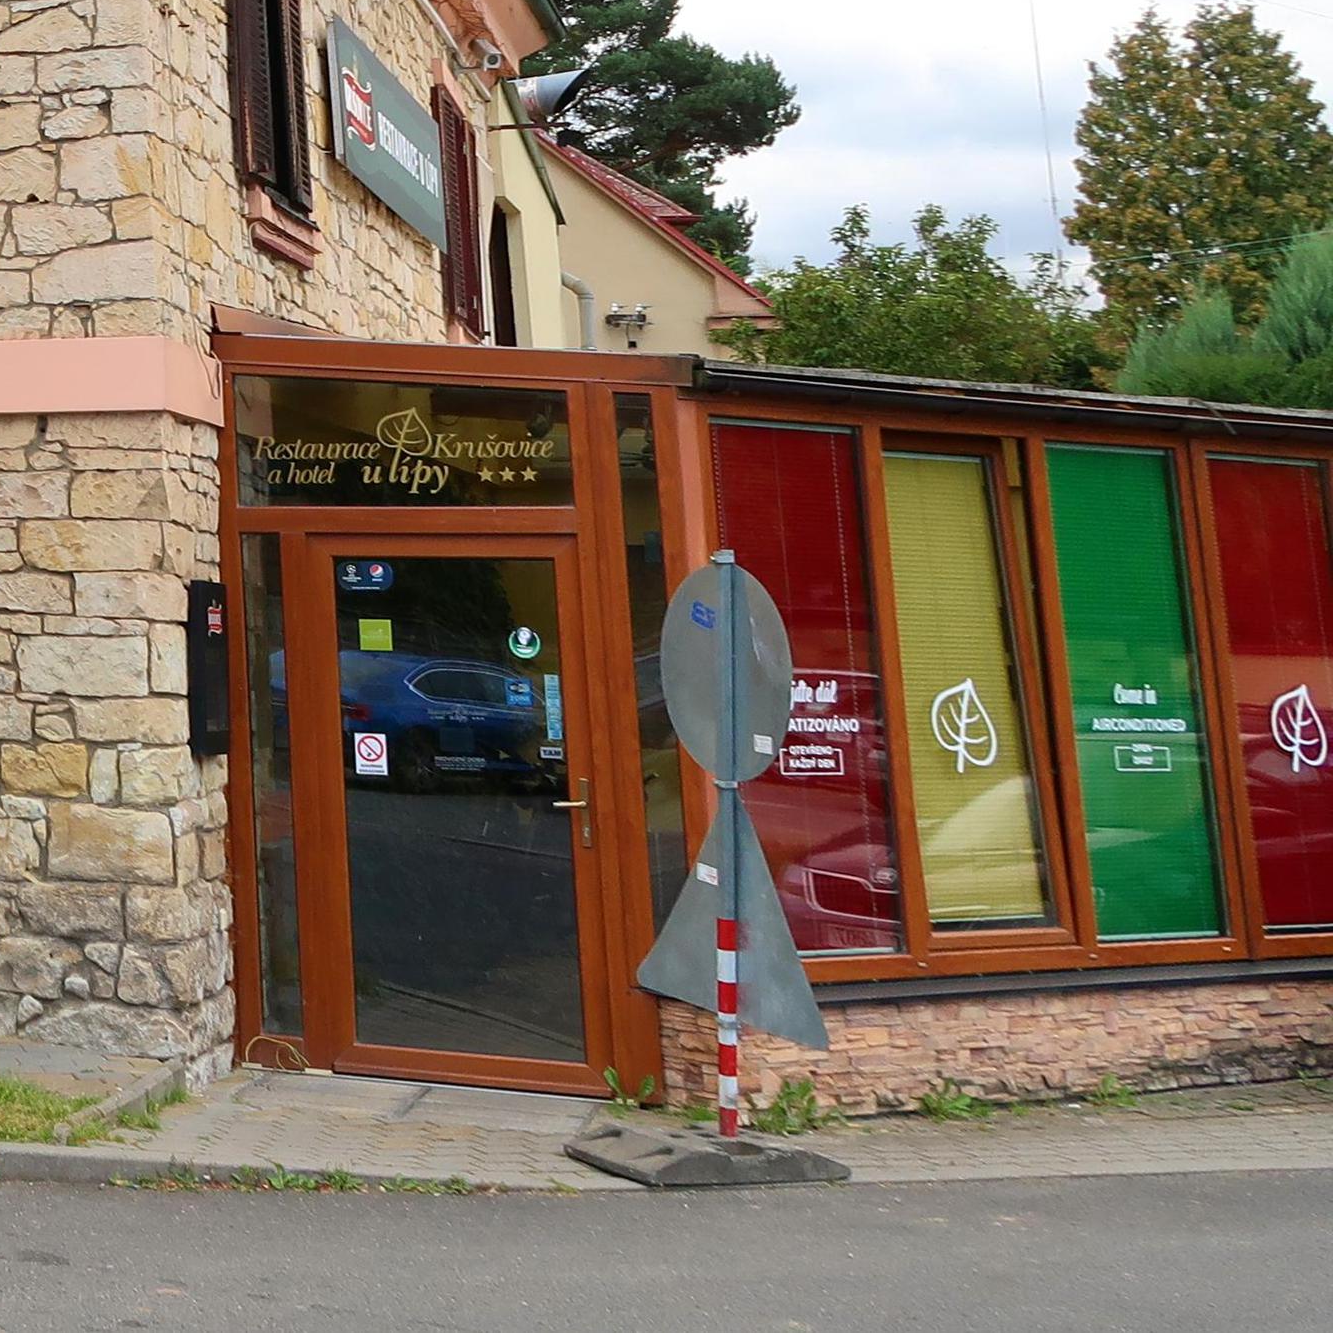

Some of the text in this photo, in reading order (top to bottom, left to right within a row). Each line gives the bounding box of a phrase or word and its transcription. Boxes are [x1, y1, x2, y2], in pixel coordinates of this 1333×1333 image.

[252, 432, 553, 461] Restaurace Krušovice
[268, 455, 449, 495] a hotel u lípy
[788, 715, 860, 732] ATIZOVÁNO
[1092, 718, 1186, 732] AIRCONDITIONED
